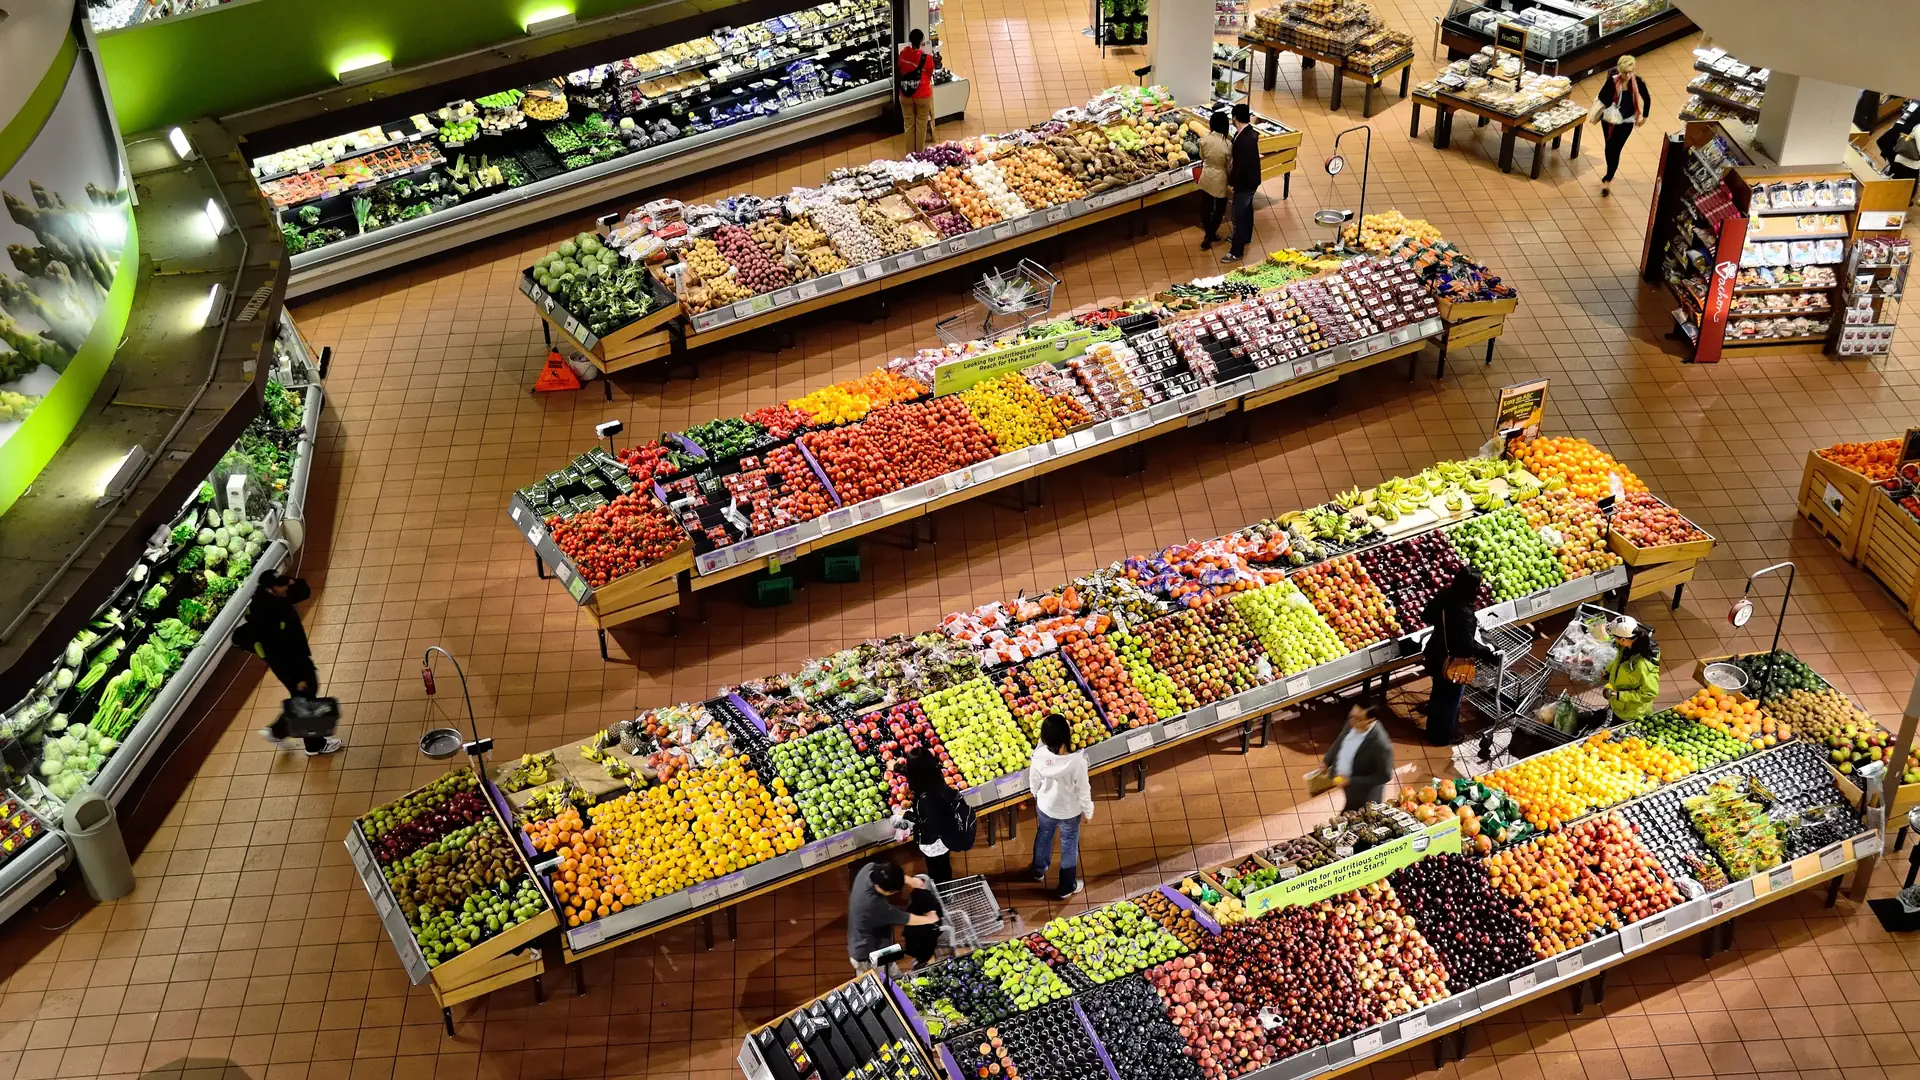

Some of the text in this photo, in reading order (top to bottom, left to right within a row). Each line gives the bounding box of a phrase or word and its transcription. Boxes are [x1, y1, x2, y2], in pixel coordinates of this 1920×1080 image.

[1713, 261, 1733, 323] Vachon
[963, 359, 987, 369] Looking
[997, 350, 1027, 361] nutritious
[1027, 342, 1053, 352] choices?
[979, 362, 997, 371] Reach
[1019, 352, 1037, 360] Stars!
[1503, 398, 1515, 407] Easy
[1285, 877, 1318, 894] Looking
[1319, 871, 1331, 881] for
[1332, 856, 1372, 876] nutritious
[1374, 842, 1408, 860] choices?
[1308, 879, 1333, 893] Reach
[1334, 873, 1346, 884] for
[1348, 869, 1361, 878] the
[1363, 858, 1387, 873] Stars!
